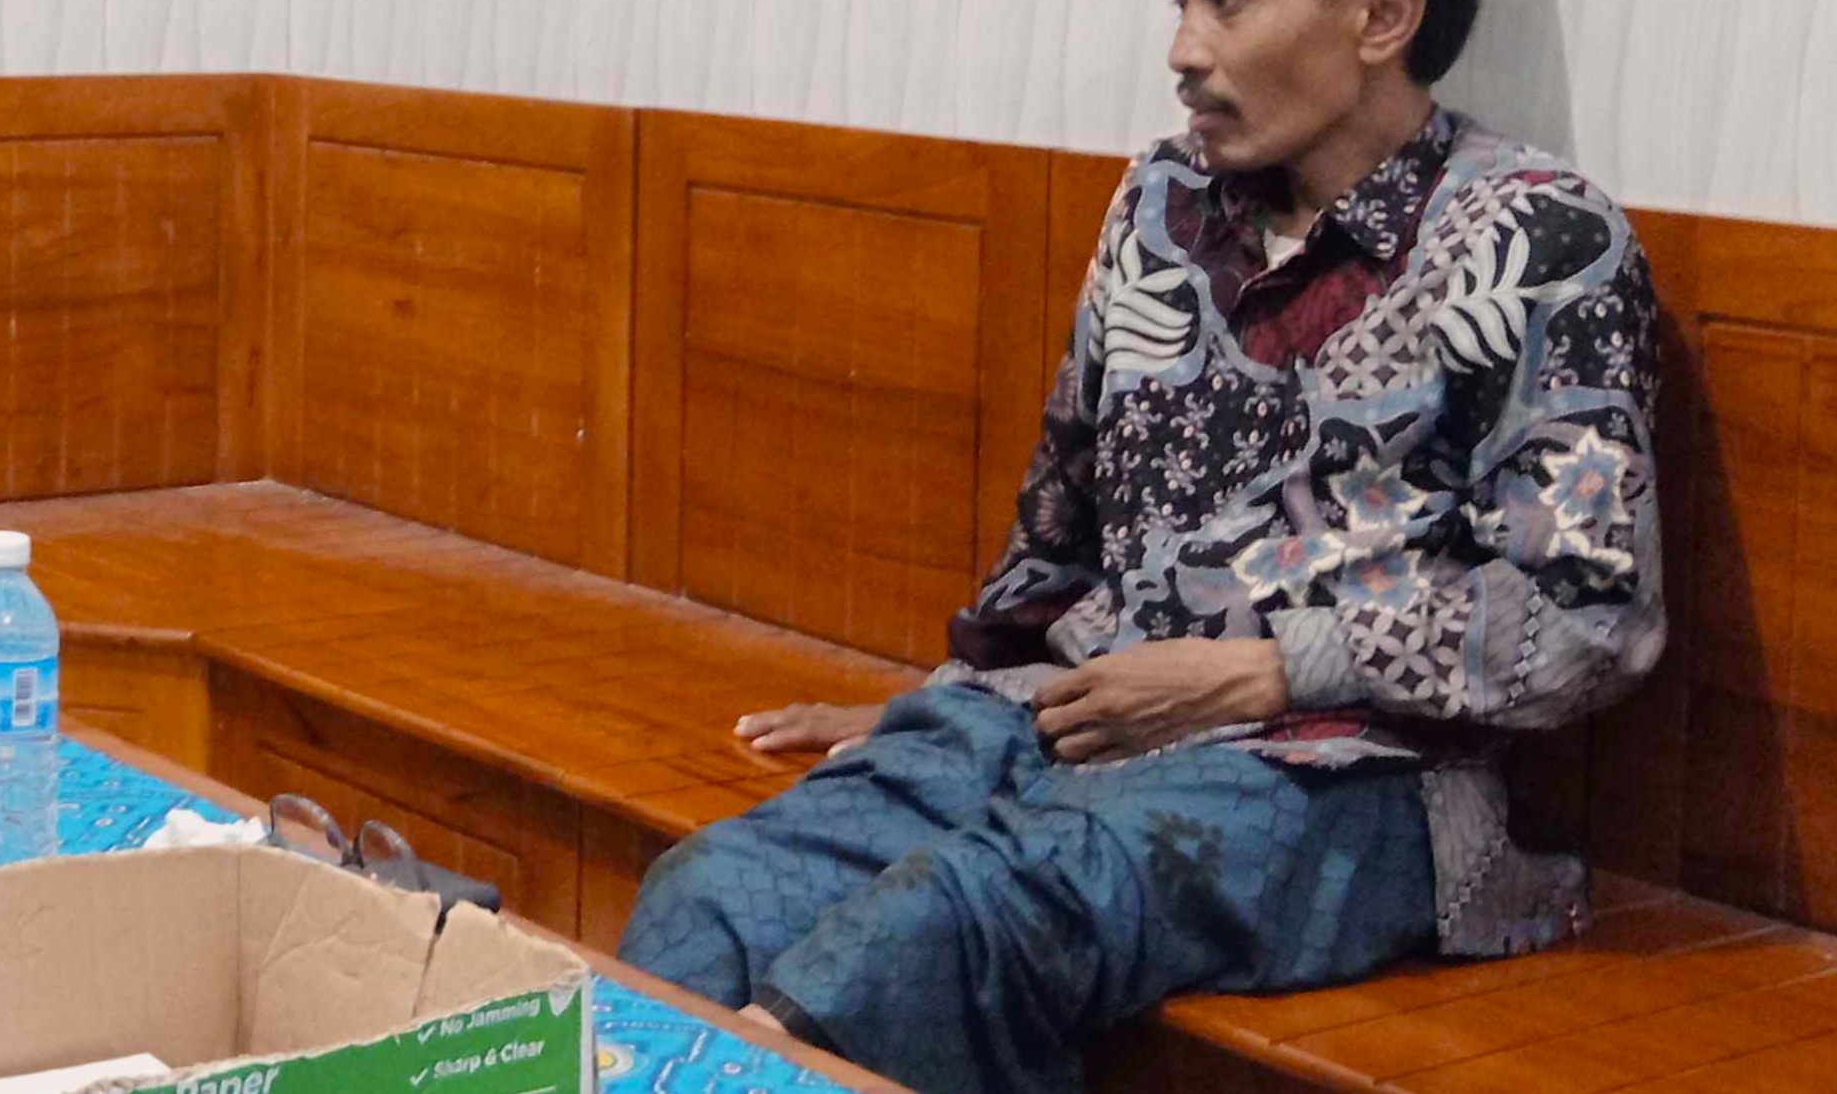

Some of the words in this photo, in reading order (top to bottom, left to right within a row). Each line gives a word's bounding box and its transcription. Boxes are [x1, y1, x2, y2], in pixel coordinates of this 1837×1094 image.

[440, 1017, 465, 1037] No
[433, 1054, 482, 1079] Sharp
[484, 1047, 498, 1067] &
[500, 1039, 546, 1063] Clear
